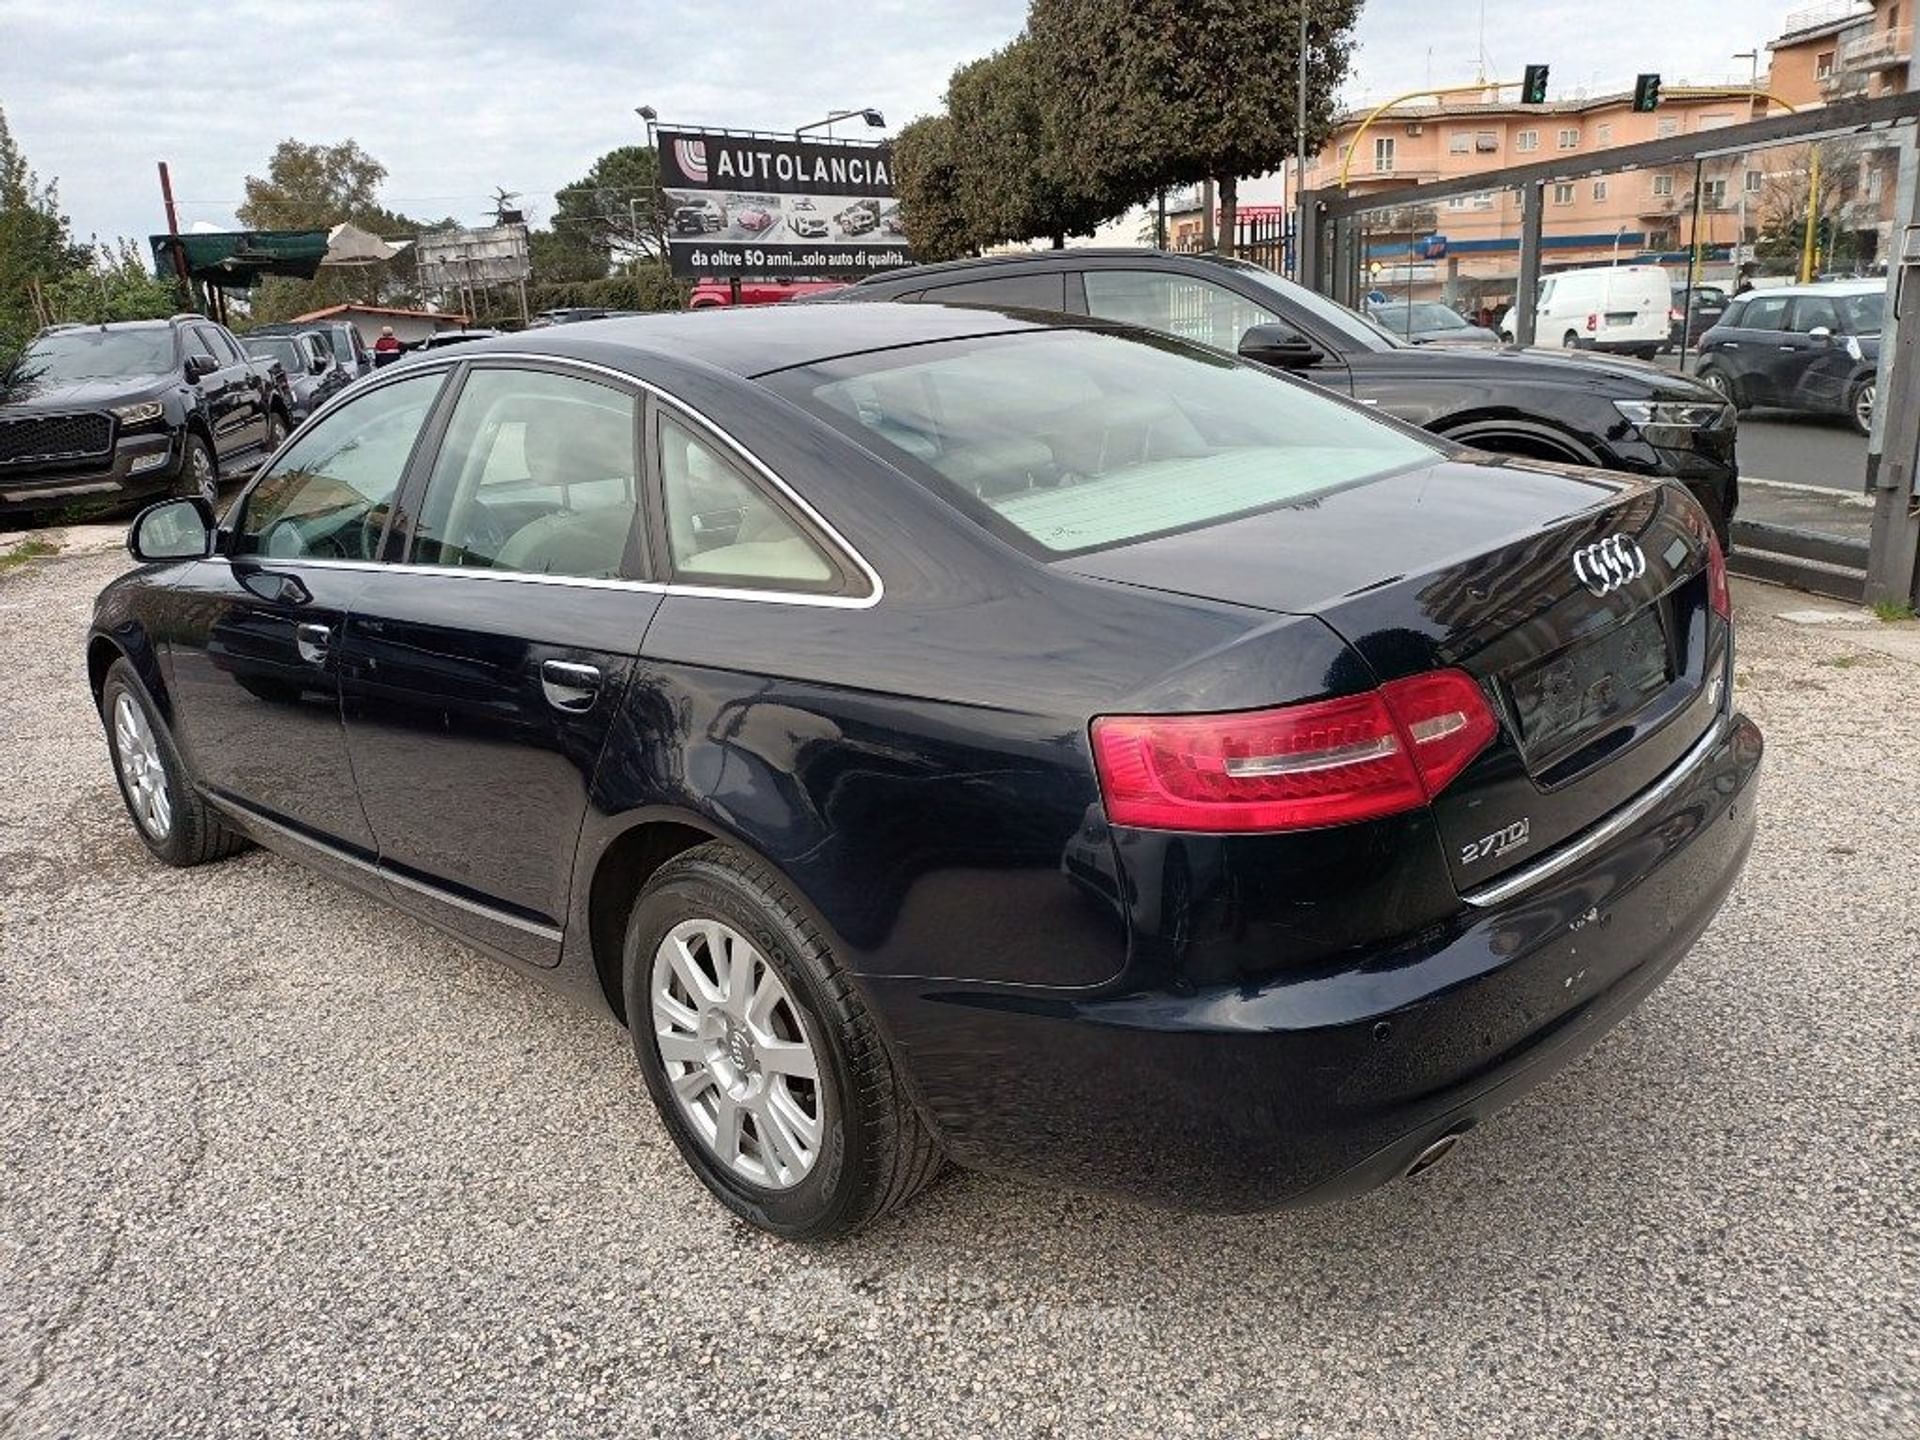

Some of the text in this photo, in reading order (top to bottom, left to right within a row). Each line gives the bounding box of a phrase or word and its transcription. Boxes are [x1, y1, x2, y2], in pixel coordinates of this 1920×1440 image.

[716, 149, 897, 186] AUTOLANCIA
[691, 249, 709, 266] da
[710, 249, 742, 266] oltre
[744, 249, 765, 266] 50
[828, 252, 853, 266] auto
[855, 250, 866, 266] di
